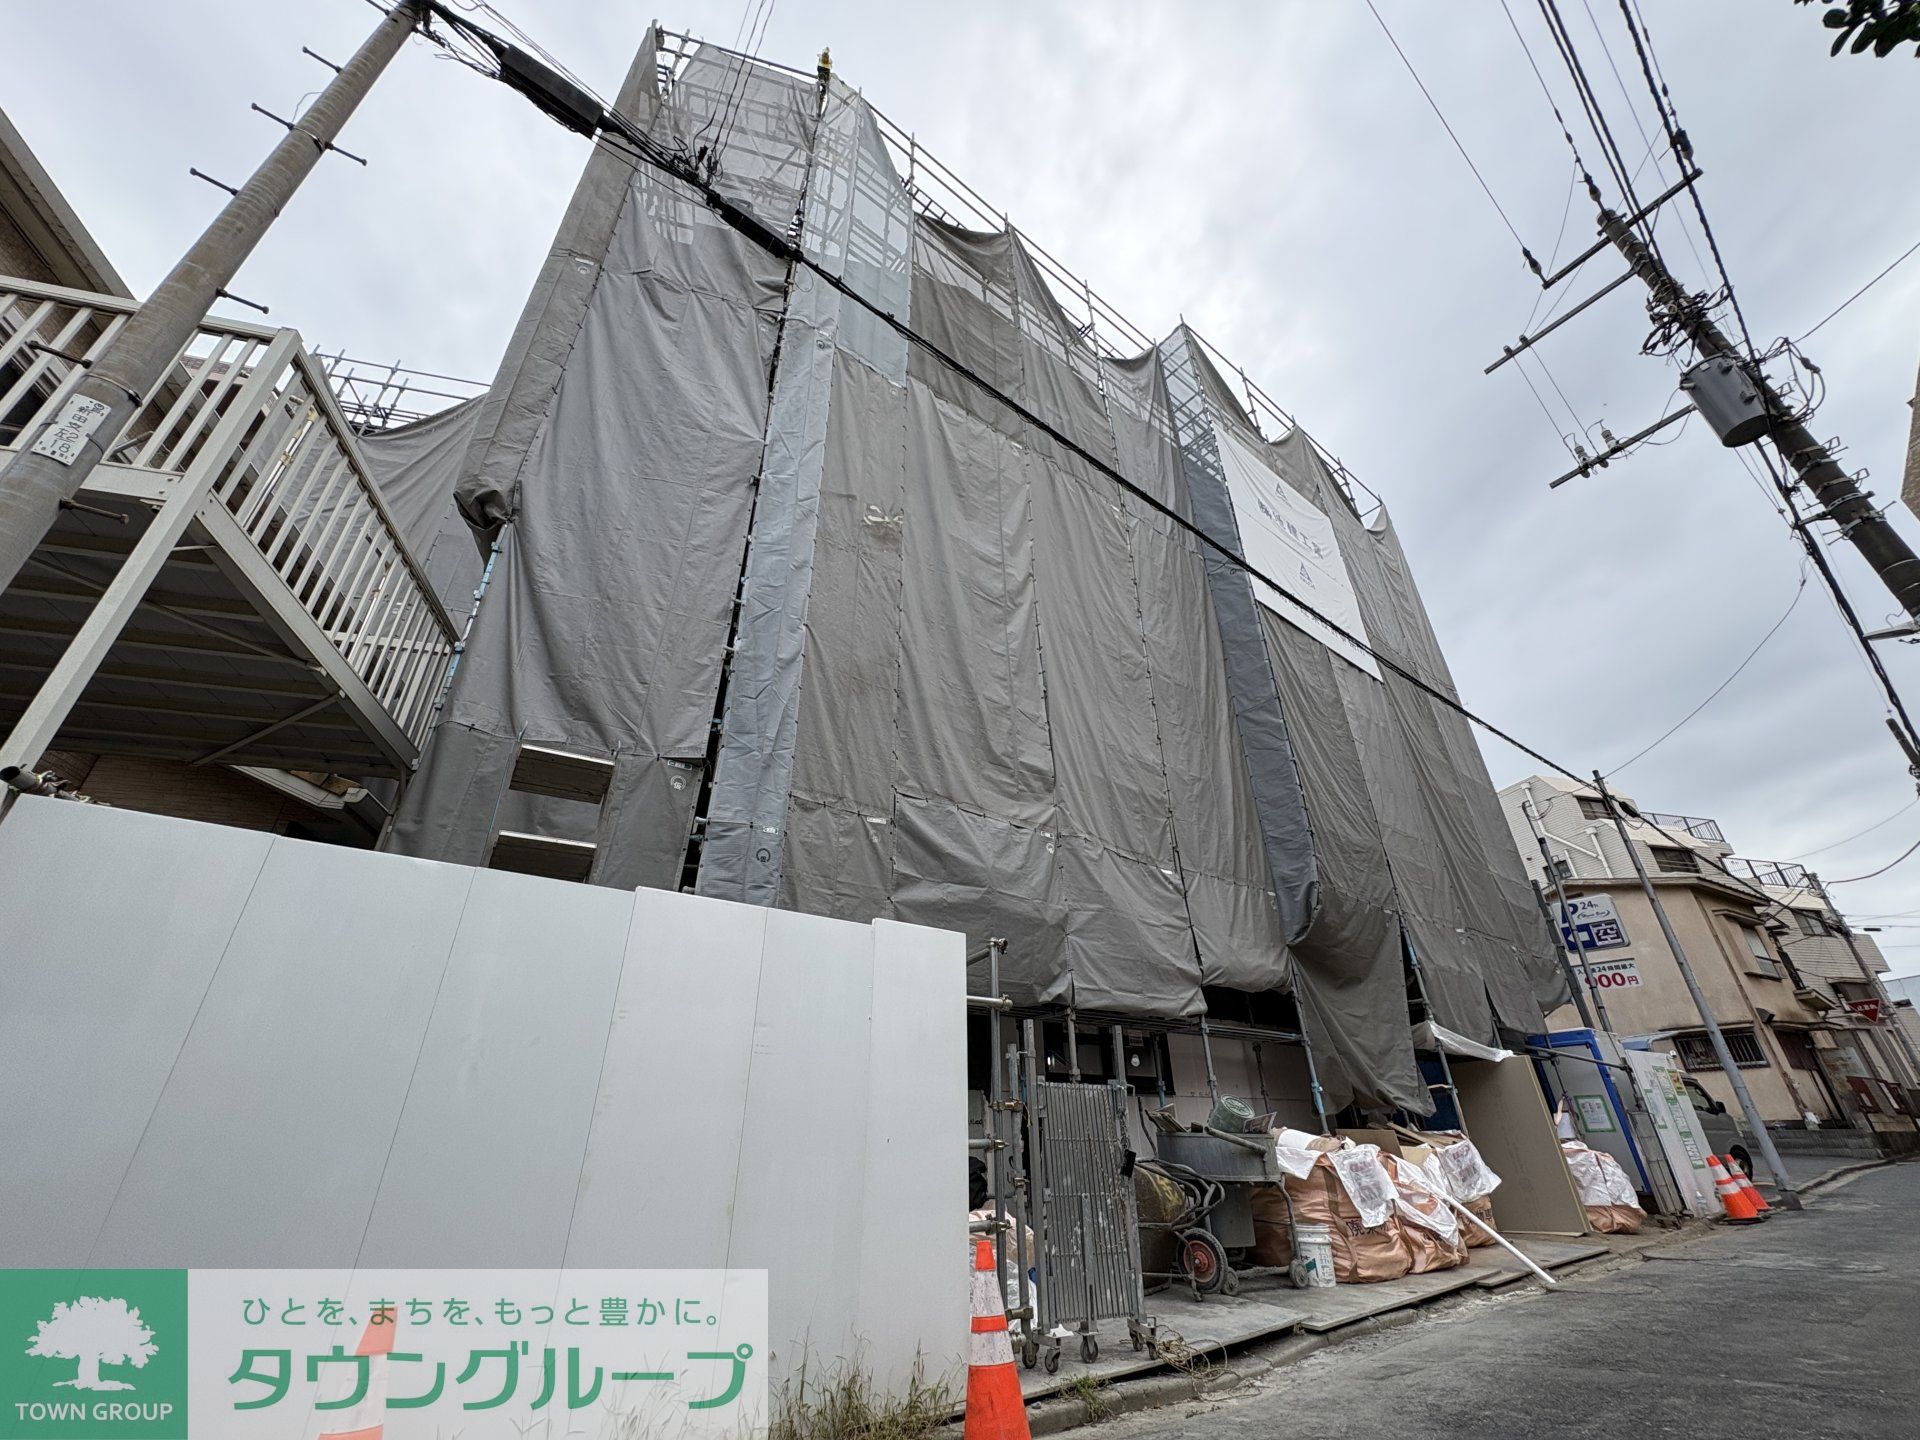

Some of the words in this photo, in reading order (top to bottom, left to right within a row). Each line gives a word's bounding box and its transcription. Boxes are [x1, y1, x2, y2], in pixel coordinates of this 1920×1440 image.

[50, 439, 70, 453] 18
[1561, 903, 1578, 924] P
[1594, 923, 1621, 945] 空
